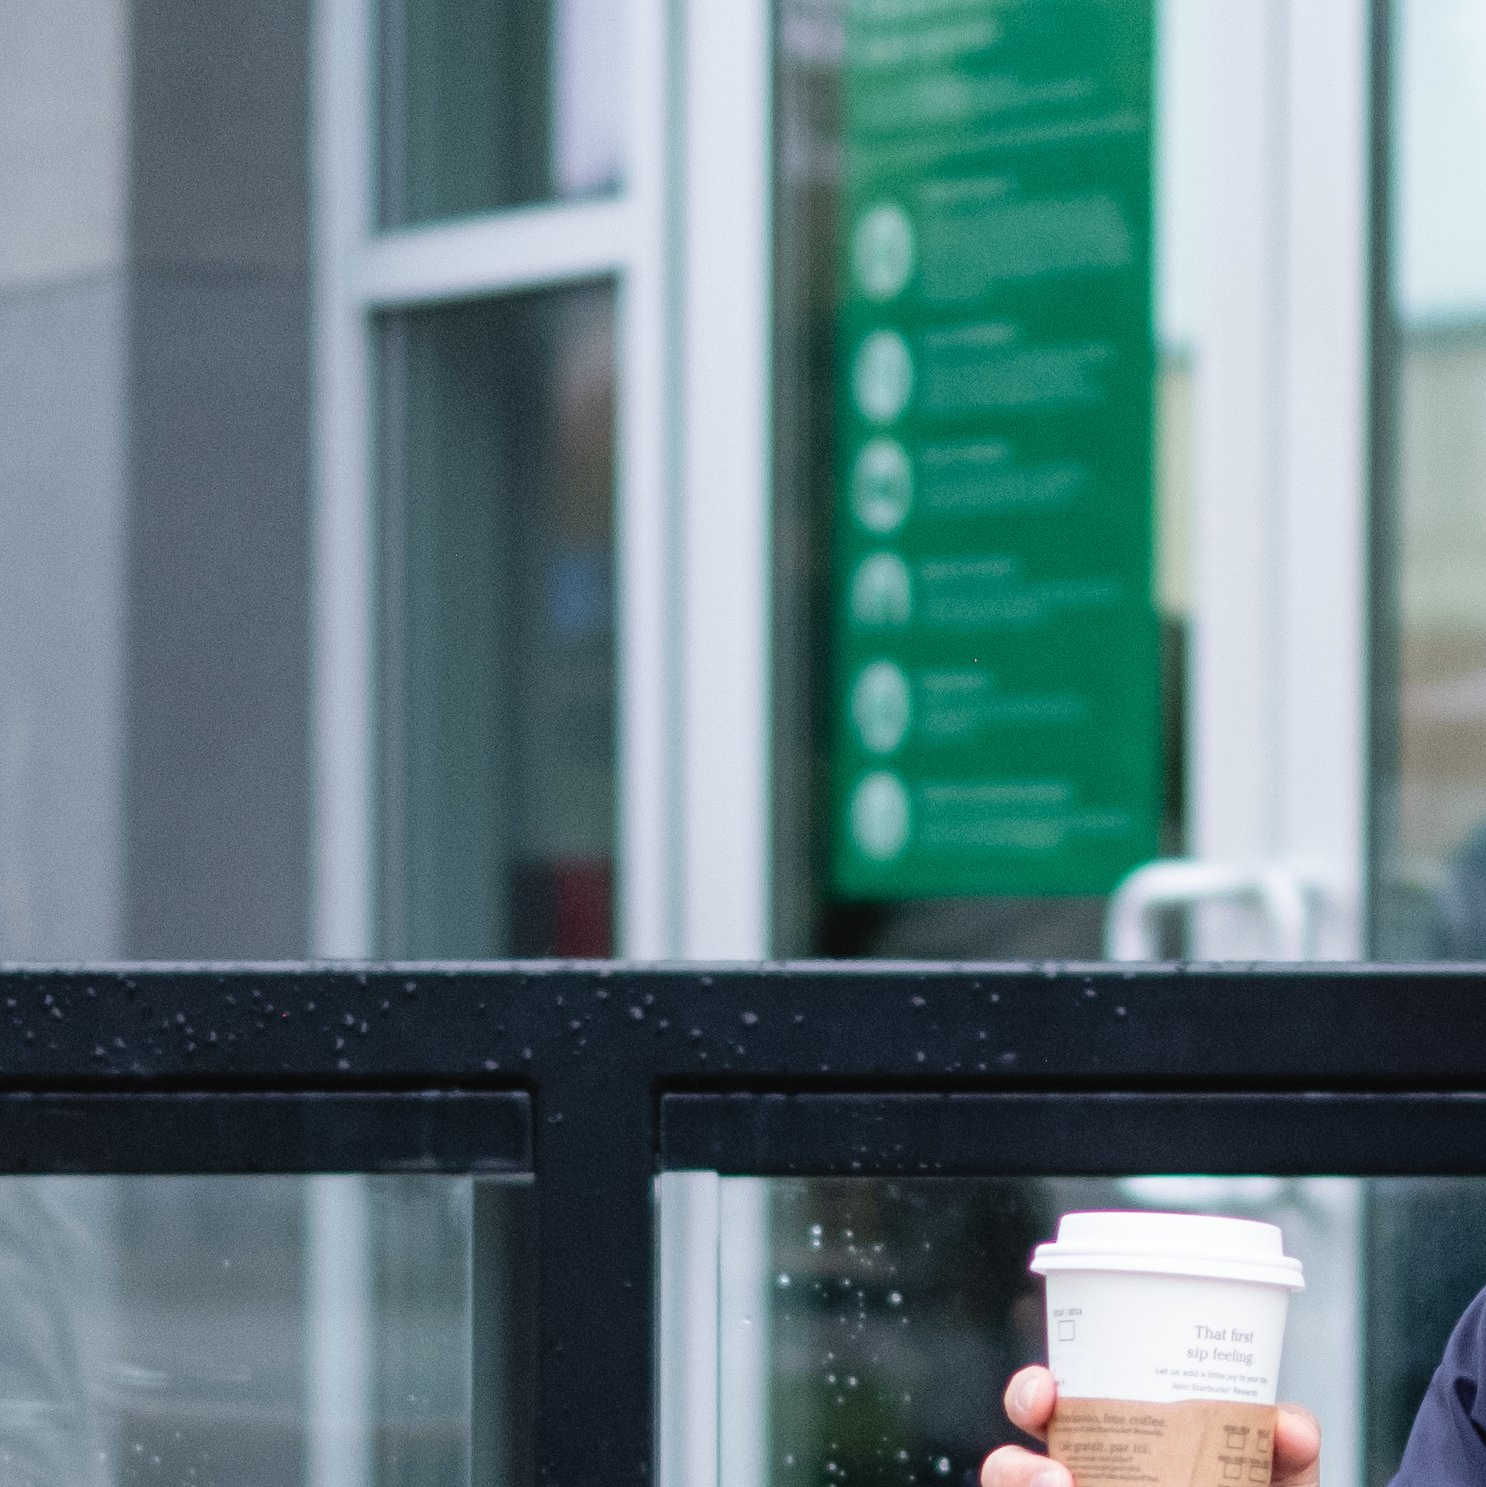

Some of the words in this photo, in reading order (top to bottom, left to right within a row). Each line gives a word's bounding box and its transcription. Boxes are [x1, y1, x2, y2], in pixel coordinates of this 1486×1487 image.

[1195, 1325, 1227, 1341] That
[1231, 1328, 1254, 1344] first
[1186, 1347, 1209, 1362] sip
